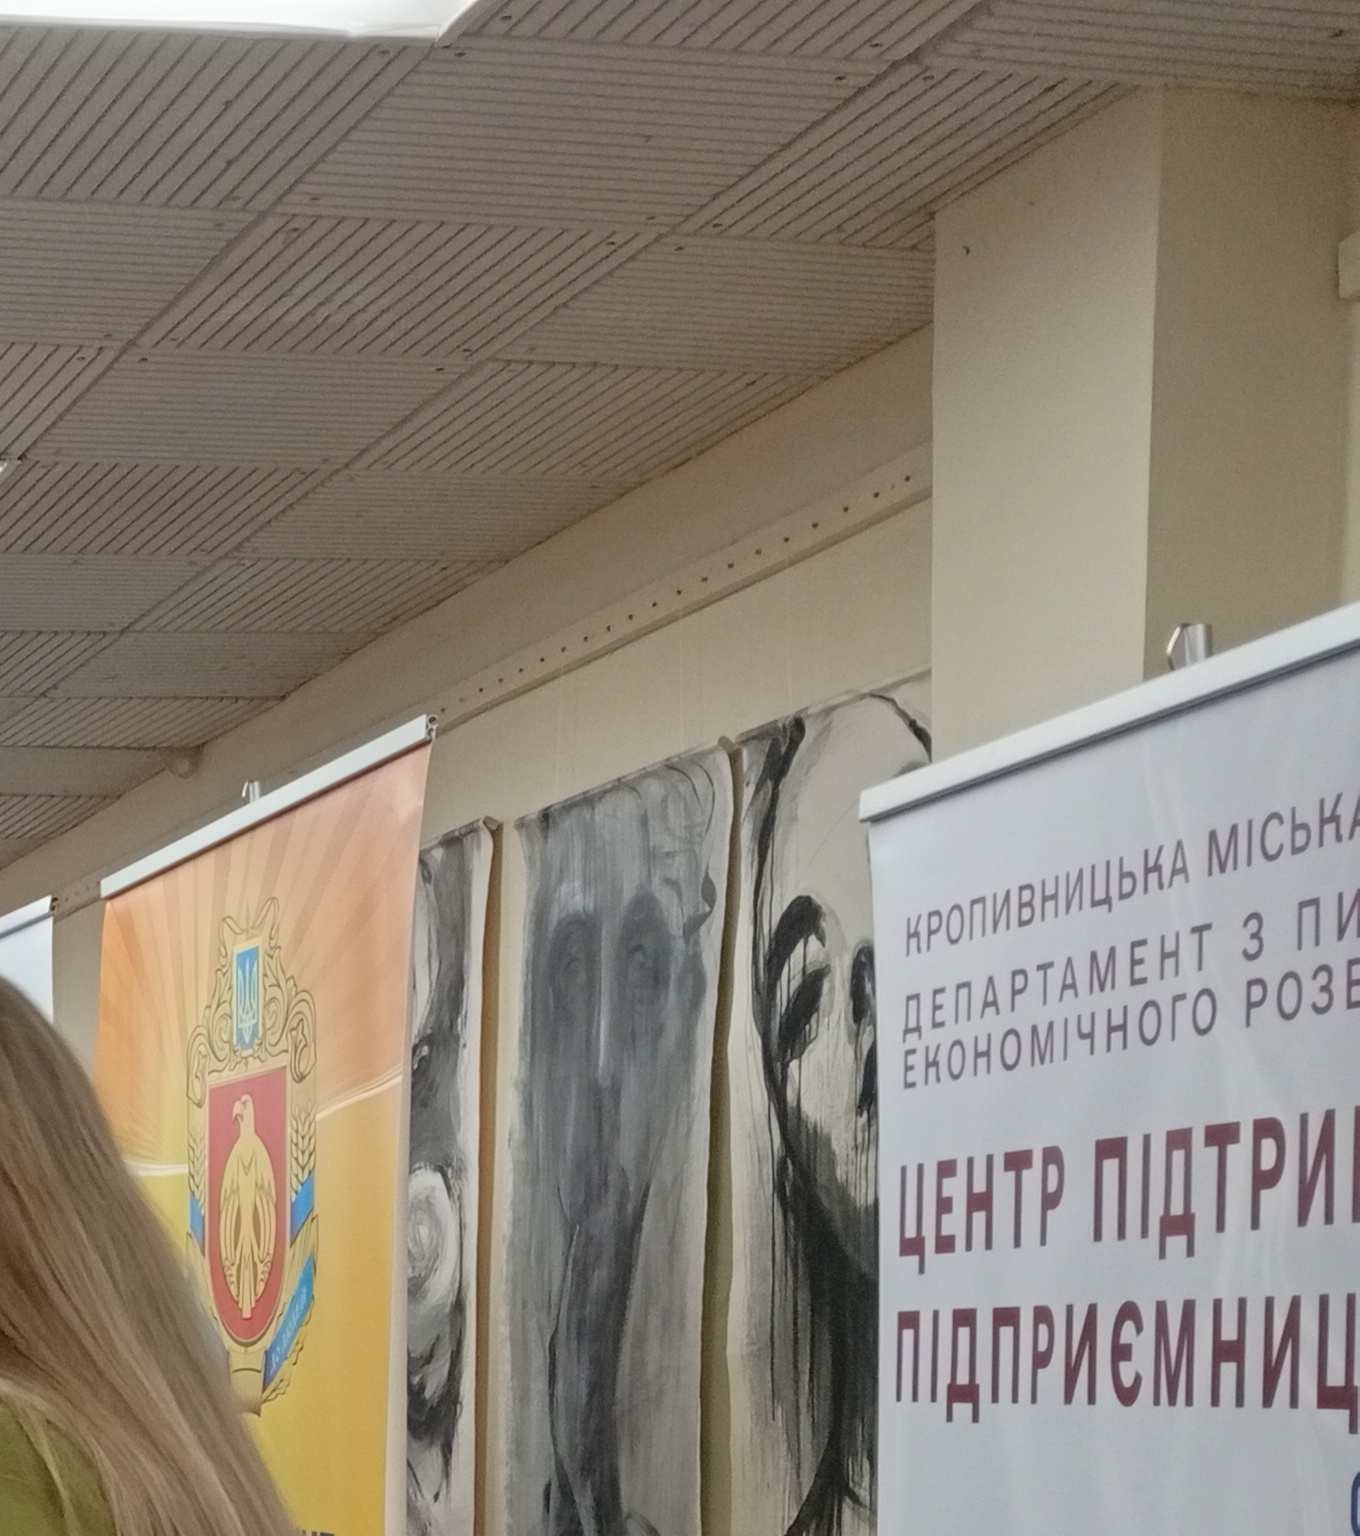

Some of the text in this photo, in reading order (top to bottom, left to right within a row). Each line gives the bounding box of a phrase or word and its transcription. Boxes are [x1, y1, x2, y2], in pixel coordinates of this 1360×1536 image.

[905, 839, 1190, 958] КРОПИВНИЦЬКА
[902, 922, 1213, 1043] ДЕПАРТАМЕНТ
[1241, 911, 1265, 962] З
[902, 988, 1218, 1089] ЕКОНОМІЧНОГО
[899, 1105, 1360, 1275] ЦЕНТР ПІДТРИ
[896, 1292, 1359, 1435] ПІДПРИЄМНИЦ
